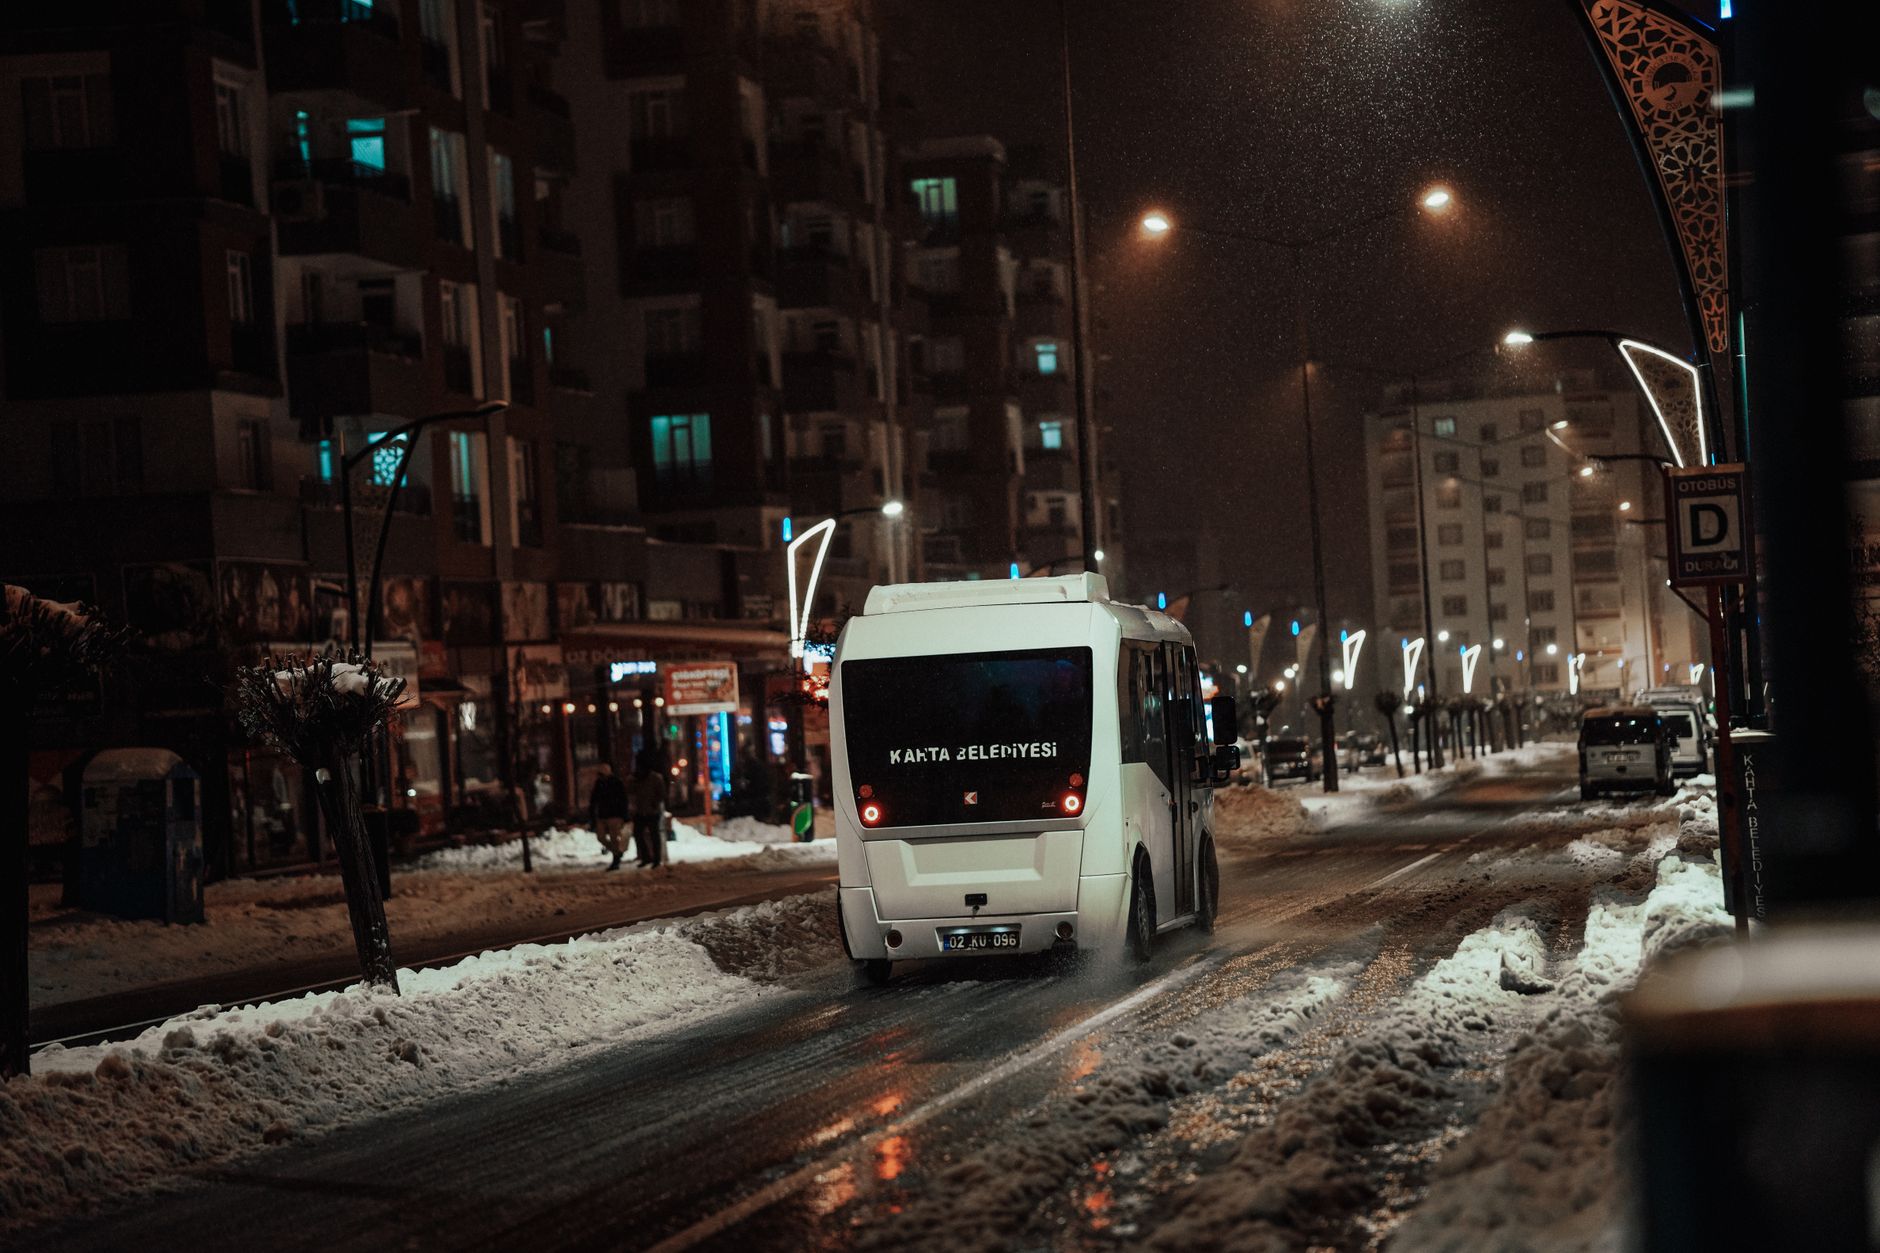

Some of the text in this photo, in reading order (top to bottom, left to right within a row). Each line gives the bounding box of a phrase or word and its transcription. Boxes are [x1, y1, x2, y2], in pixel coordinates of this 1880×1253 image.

[1690, 504, 1728, 546] D
[1743, 755, 1765, 918] KAHTA BELEDIYES
[949, 936, 965, 949] 02
[993, 933, 1017, 947] 096
